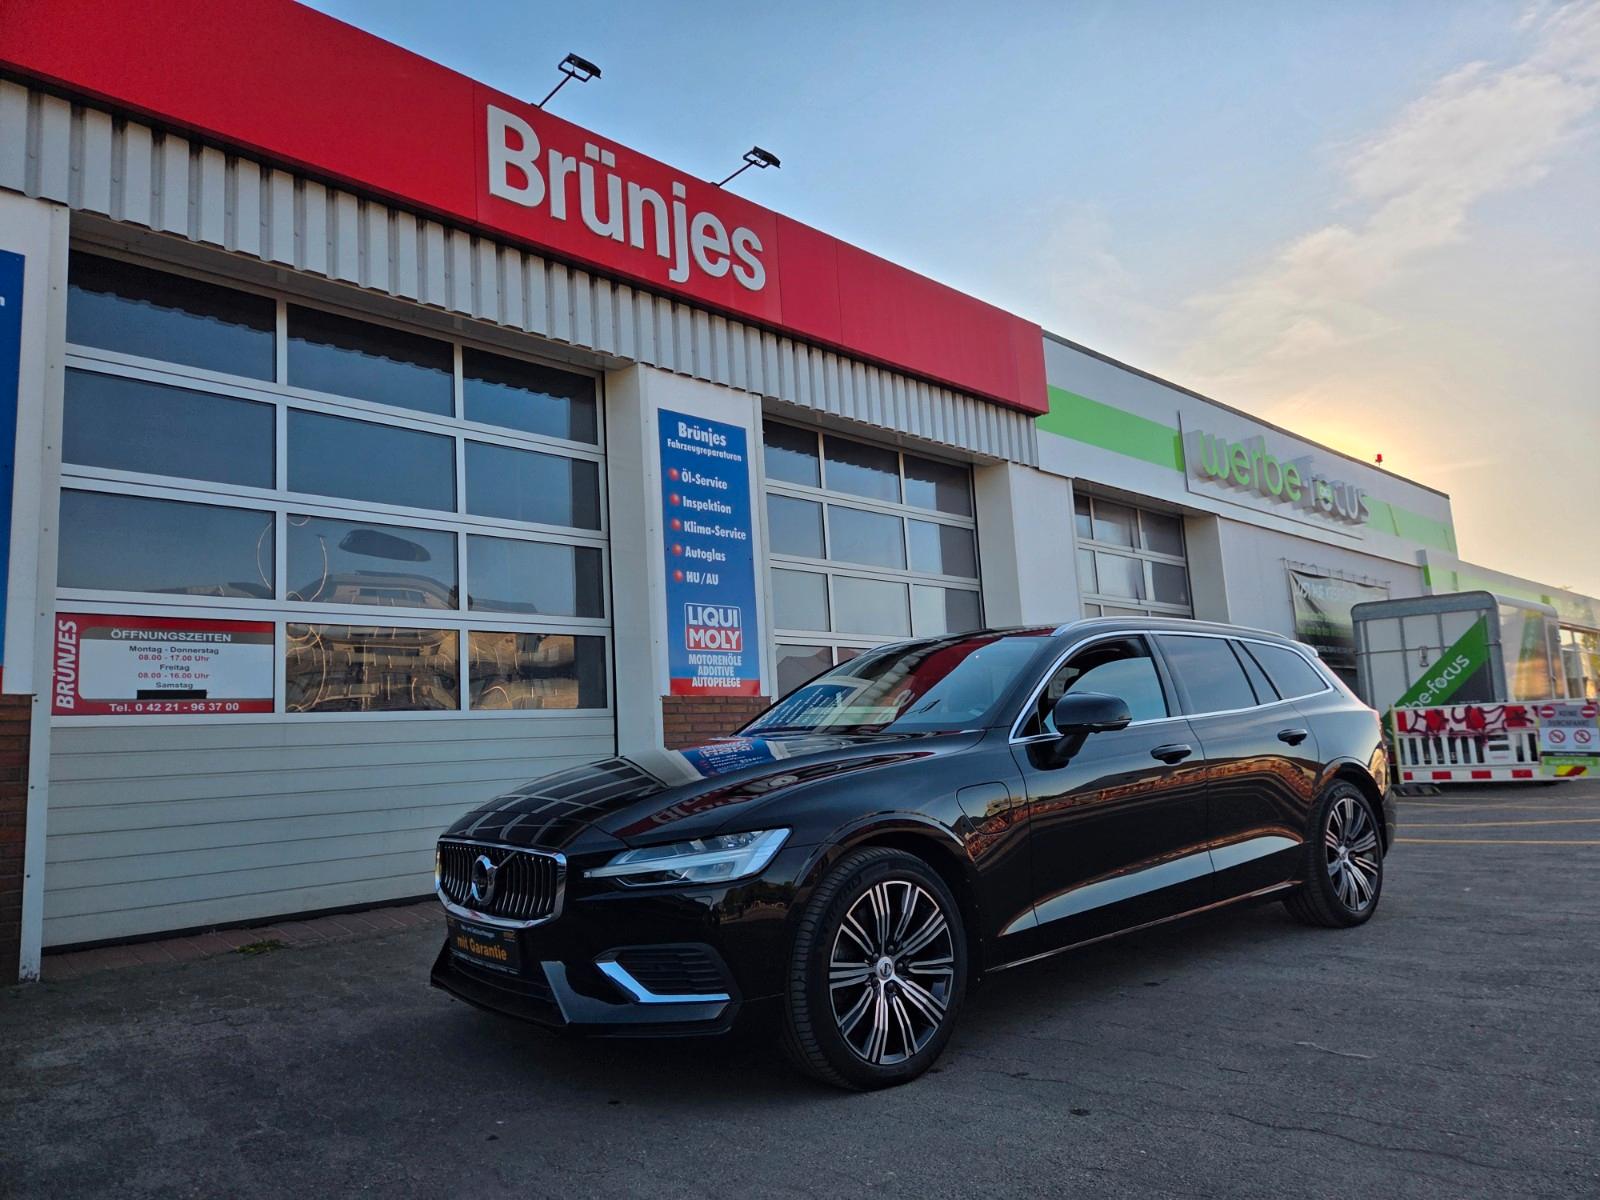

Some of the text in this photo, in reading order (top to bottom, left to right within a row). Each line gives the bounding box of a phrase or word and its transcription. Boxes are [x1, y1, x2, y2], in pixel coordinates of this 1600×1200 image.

[487, 103, 766, 291] Brünjes
[678, 421, 727, 447] Brünjes
[667, 438, 742, 462] Fahrzeugreparaturen
[1197, 430, 1302, 501] werbe
[681, 468, 728, 490] Öl-Service
[682, 495, 732, 514] Inspektion
[684, 520, 746, 540] Klima-Service
[685, 546, 726, 562] Autoglas
[687, 605, 739, 628] LIQUI
[111, 628, 232, 642] ÖFFNUNGSZEITEN
[688, 628, 740, 649] MOLY
[129, 645, 162, 654] Montag
[170, 646, 219, 655] Donnerstag
[688, 653, 742, 666] MOTORENÖLE
[53, 620, 77, 709] BRÜNJES
[160, 664, 190, 672] Freitag
[697, 666, 735, 677] ADDITIVE
[155, 681, 194, 689] Samstag
[691, 676, 741, 688] AUTOPFLEGE
[109, 703, 131, 712] Tel.
[135, 703, 143, 711] 0
[146, 703, 161, 711] 42
[164, 703, 179, 711] 21
[191, 703, 205, 711] 96
[208, 703, 222, 711] 37
[225, 702, 240, 711] 00
